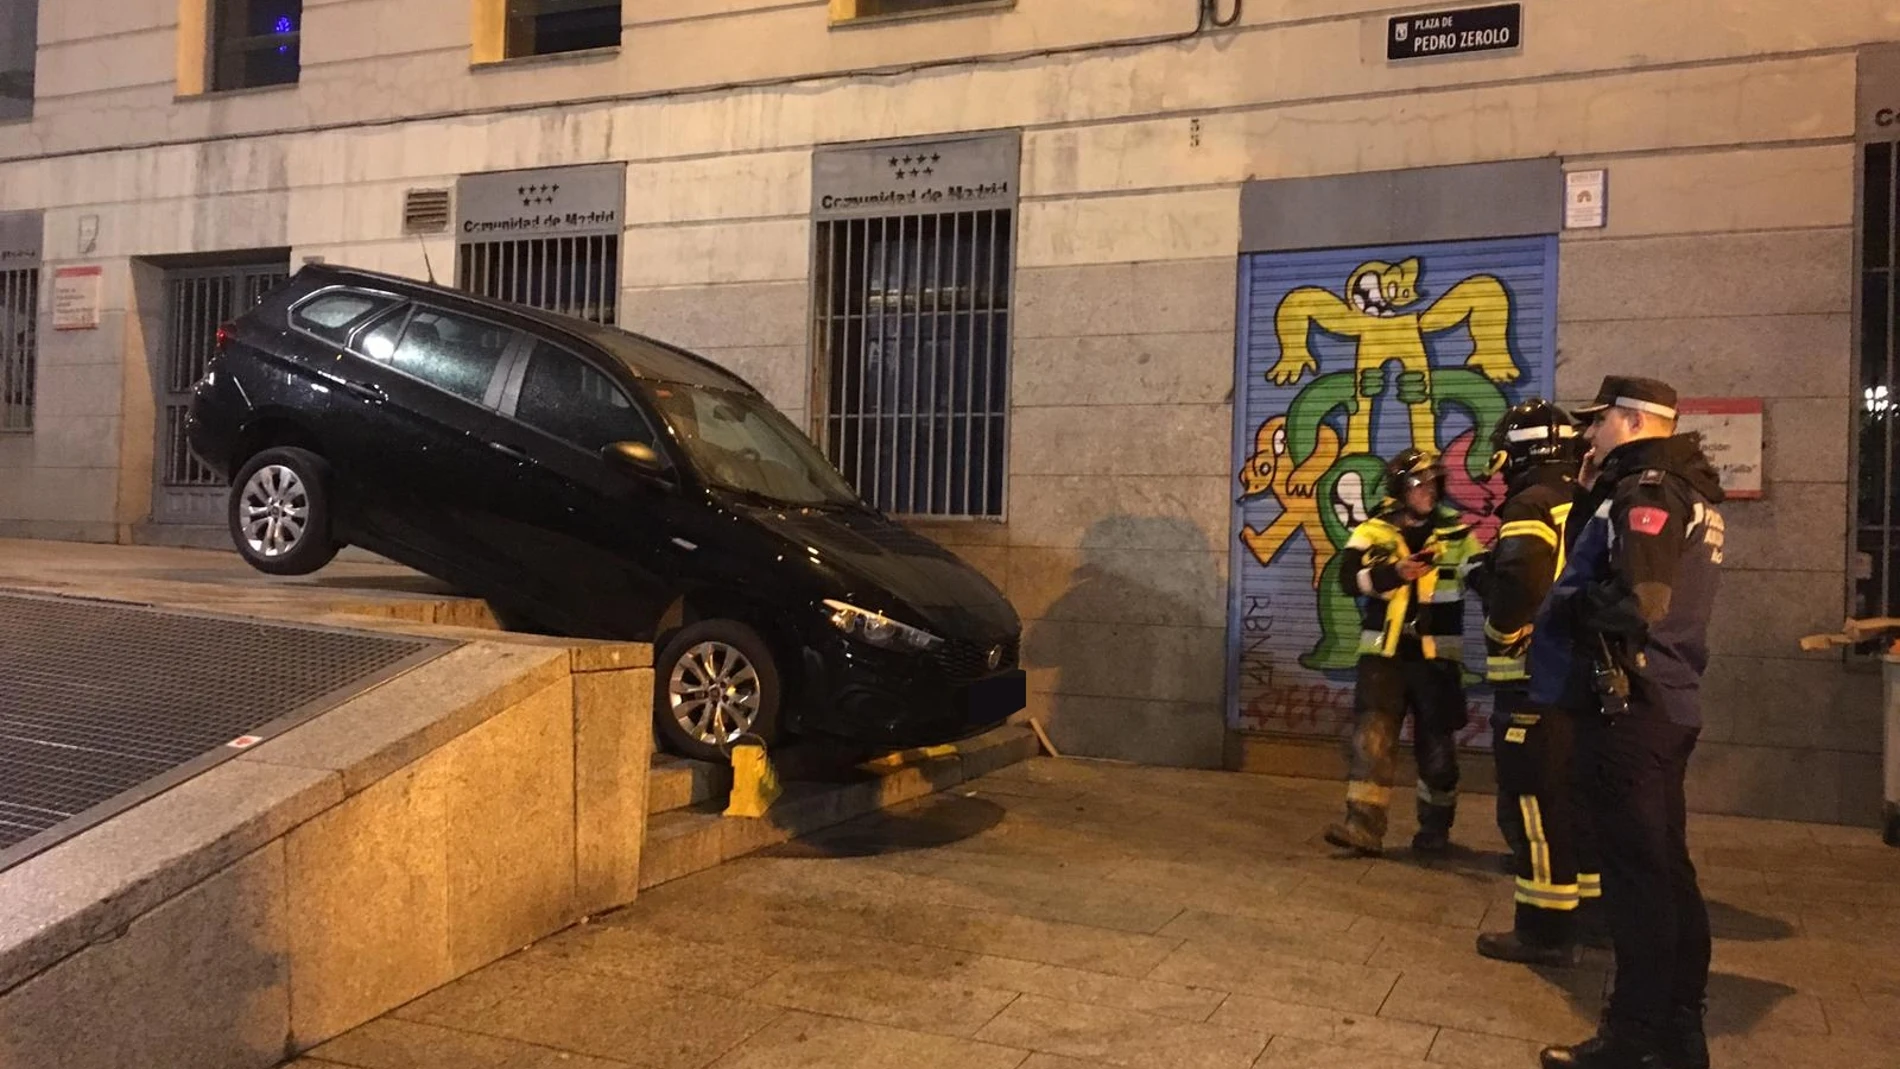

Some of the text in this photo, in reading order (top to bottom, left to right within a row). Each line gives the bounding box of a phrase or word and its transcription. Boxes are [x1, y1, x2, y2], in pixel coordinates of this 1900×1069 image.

[1414, 16, 1453, 30] PLAZA DE
[1414, 27, 1510, 52] PEDRO ZEROLO
[821, 181, 1008, 209] Comunidad de Madrid
[463, 210, 615, 233] Comunidad de Madrid
